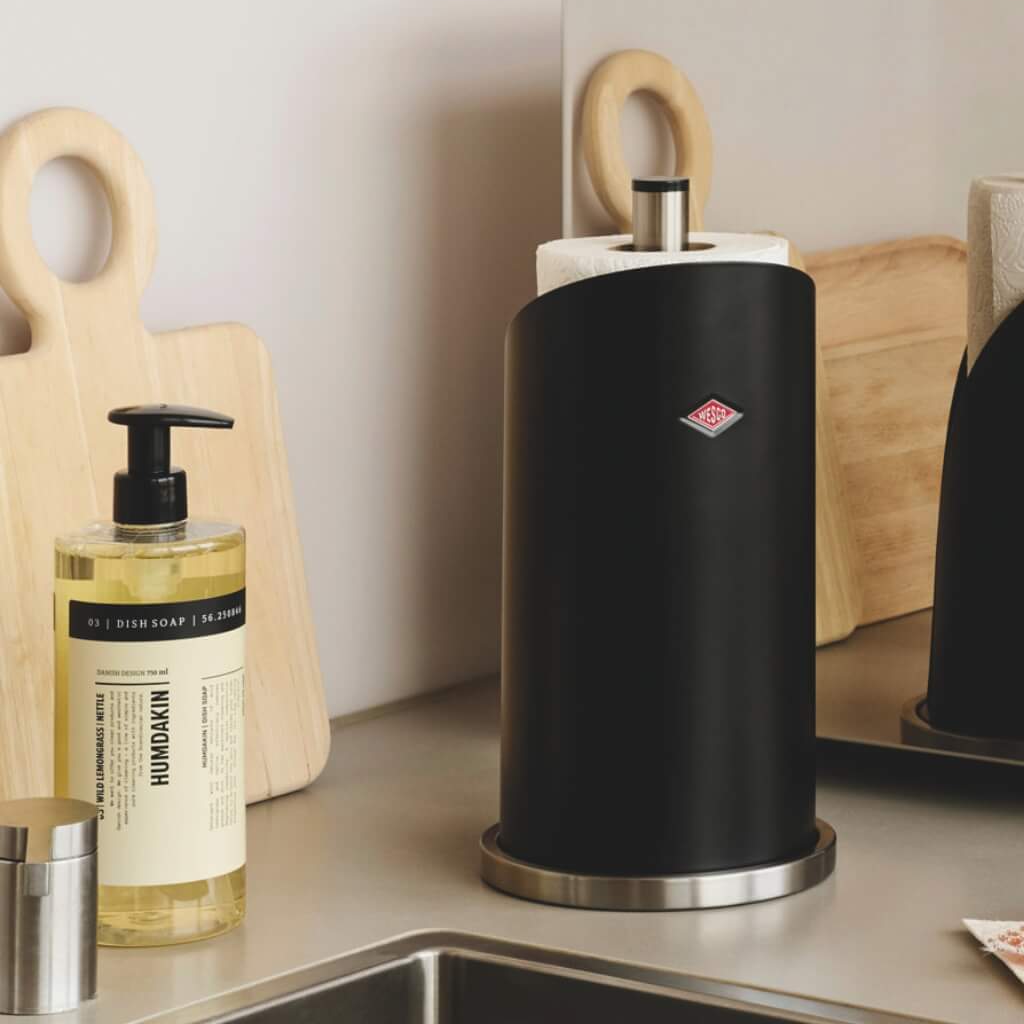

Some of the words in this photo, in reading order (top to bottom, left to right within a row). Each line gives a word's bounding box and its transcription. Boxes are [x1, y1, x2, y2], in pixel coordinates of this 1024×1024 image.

[698, 405, 726, 424] WESCO
[88, 617, 100, 628] 03
[117, 618, 148, 629] DISH
[151, 616, 186, 628] SOAP
[96, 693, 105, 722] NETTLE
[150, 690, 170, 786] HUMDAKIN
[96, 727, 105, 781] LEMONGRASS
[96, 782, 105, 803] WILD
